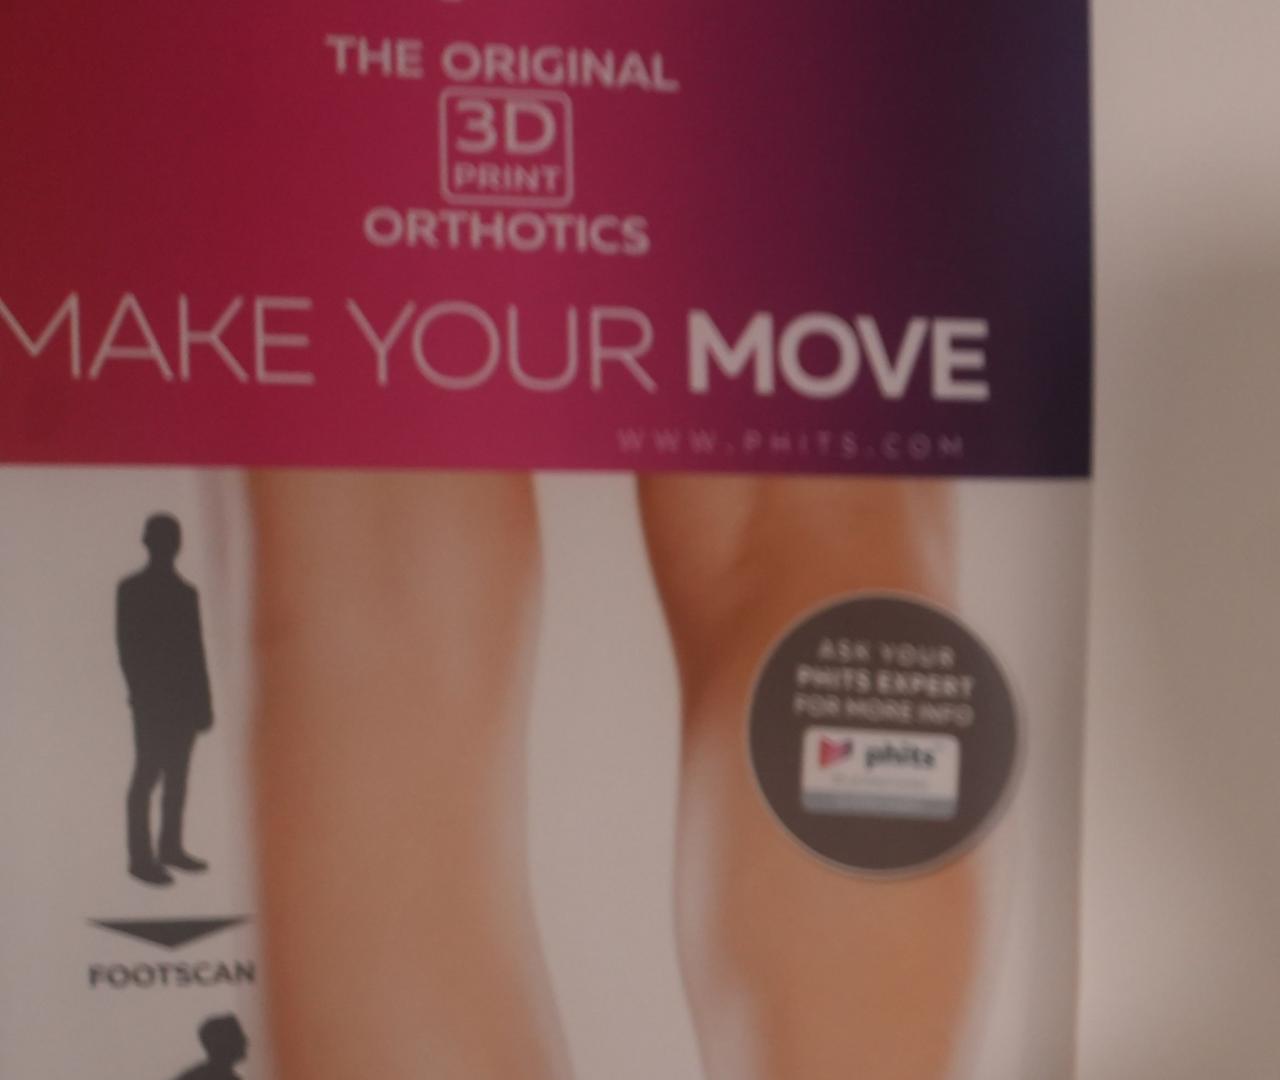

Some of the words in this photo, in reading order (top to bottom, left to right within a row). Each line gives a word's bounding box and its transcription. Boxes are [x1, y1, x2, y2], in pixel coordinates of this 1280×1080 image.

[325, 33, 425, 80] THE
[441, 41, 681, 94] ORIGINAL
[454, 98, 558, 155] 3D
[453, 162, 563, 194] PRINT
[362, 205, 652, 257] ORTHOTICS
[0, 292, 315, 385] MAKE
[345, 300, 657, 393] YOUR
[687, 308, 991, 401] MOVE
[615, 427, 965, 461] WWW.PHITS.COM
[87, 960, 257, 990] FOOTSCAN
